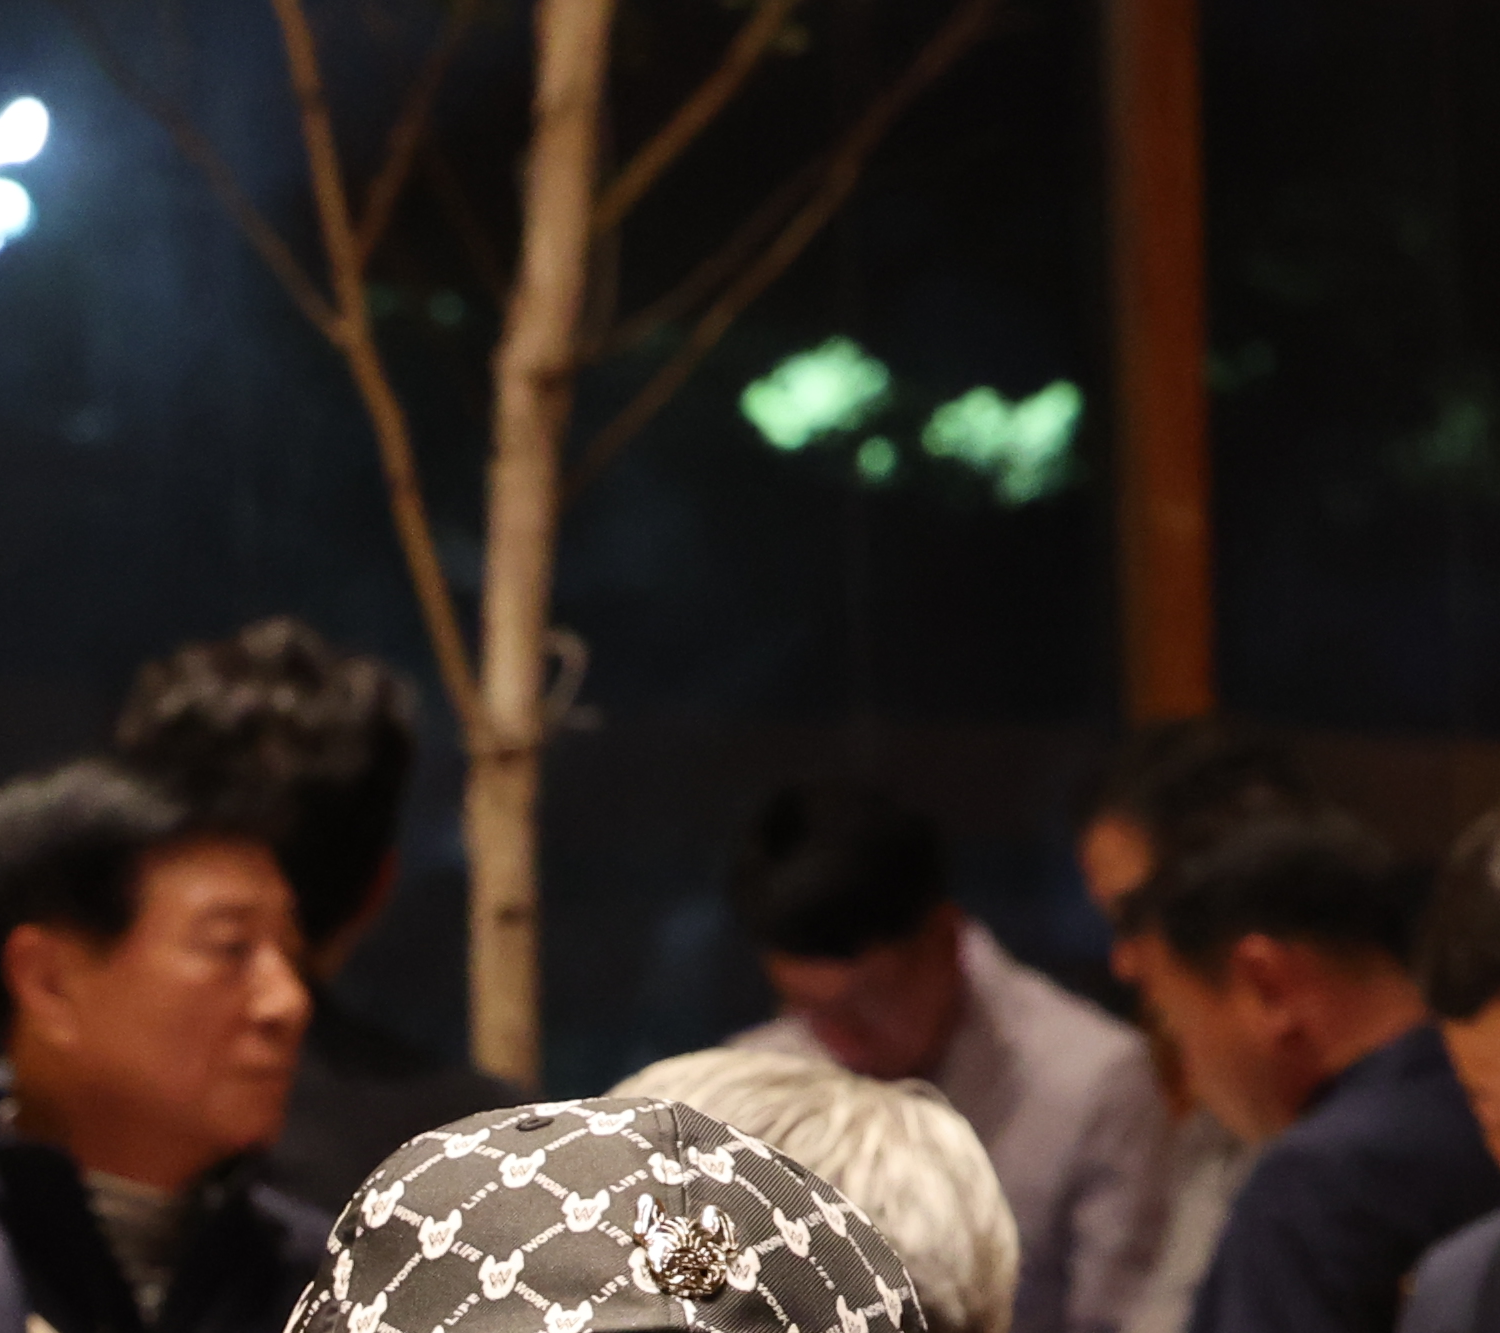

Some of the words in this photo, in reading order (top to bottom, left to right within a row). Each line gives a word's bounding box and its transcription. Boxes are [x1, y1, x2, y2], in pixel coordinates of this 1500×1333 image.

[545, 1128, 588, 1150] WORK
[620, 1129, 653, 1148] LIFE
[534, 1172, 569, 1199] WORK
[610, 1169, 649, 1193] LIFE
[461, 1181, 498, 1210] LIFE
[521, 1222, 566, 1253] WORK
[598, 1221, 633, 1247] LIFE
[451, 1241, 483, 1262] LIFE
[513, 1281, 550, 1311] WORK
[591, 1274, 630, 1304] LIFE
[445, 1293, 480, 1326] LIFE
[758, 1283, 790, 1326] WORK
